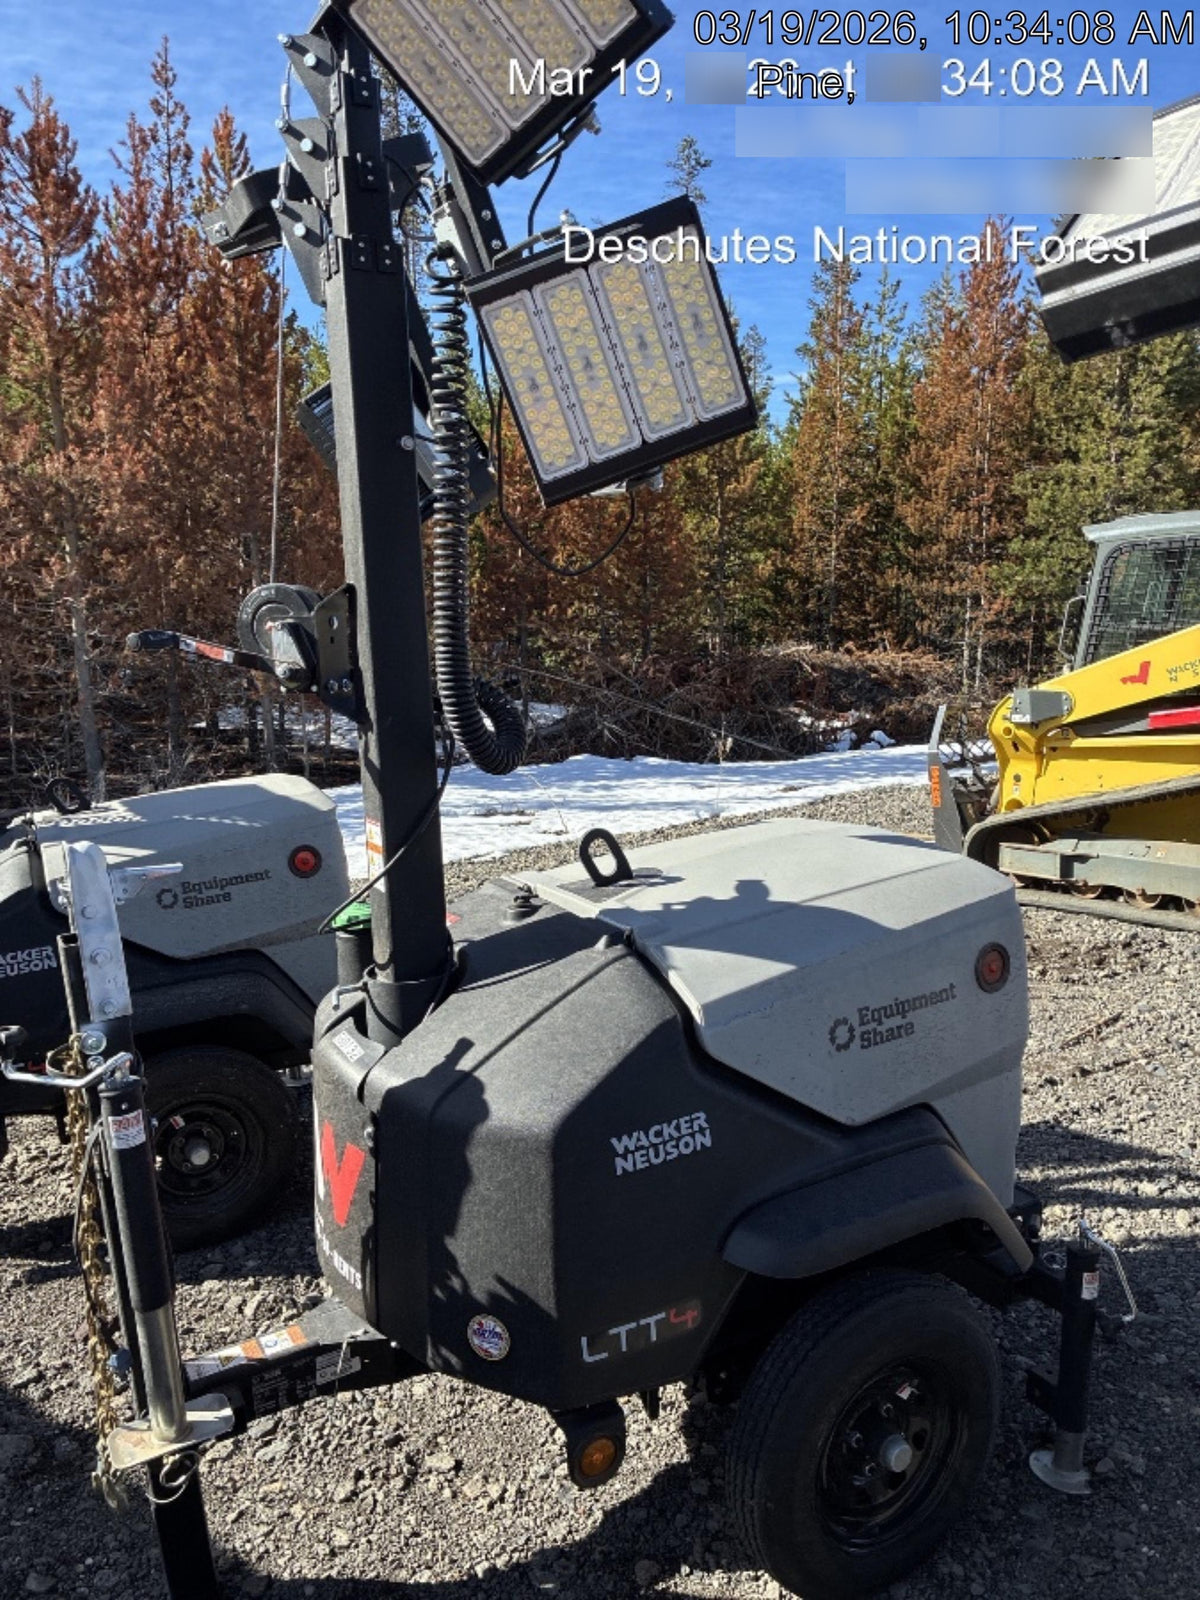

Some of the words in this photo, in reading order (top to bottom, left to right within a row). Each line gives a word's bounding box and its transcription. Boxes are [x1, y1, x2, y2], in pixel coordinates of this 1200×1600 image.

[180, 869, 273, 895] Equipment
[182, 891, 232, 909] Share
[857, 982, 957, 1027] Equipment
[860, 1021, 915, 1050] Share
[609, 1112, 710, 1154] WACKER
[614, 1128, 712, 1176] NEUSON
[581, 1307, 699, 1363] LTT4
